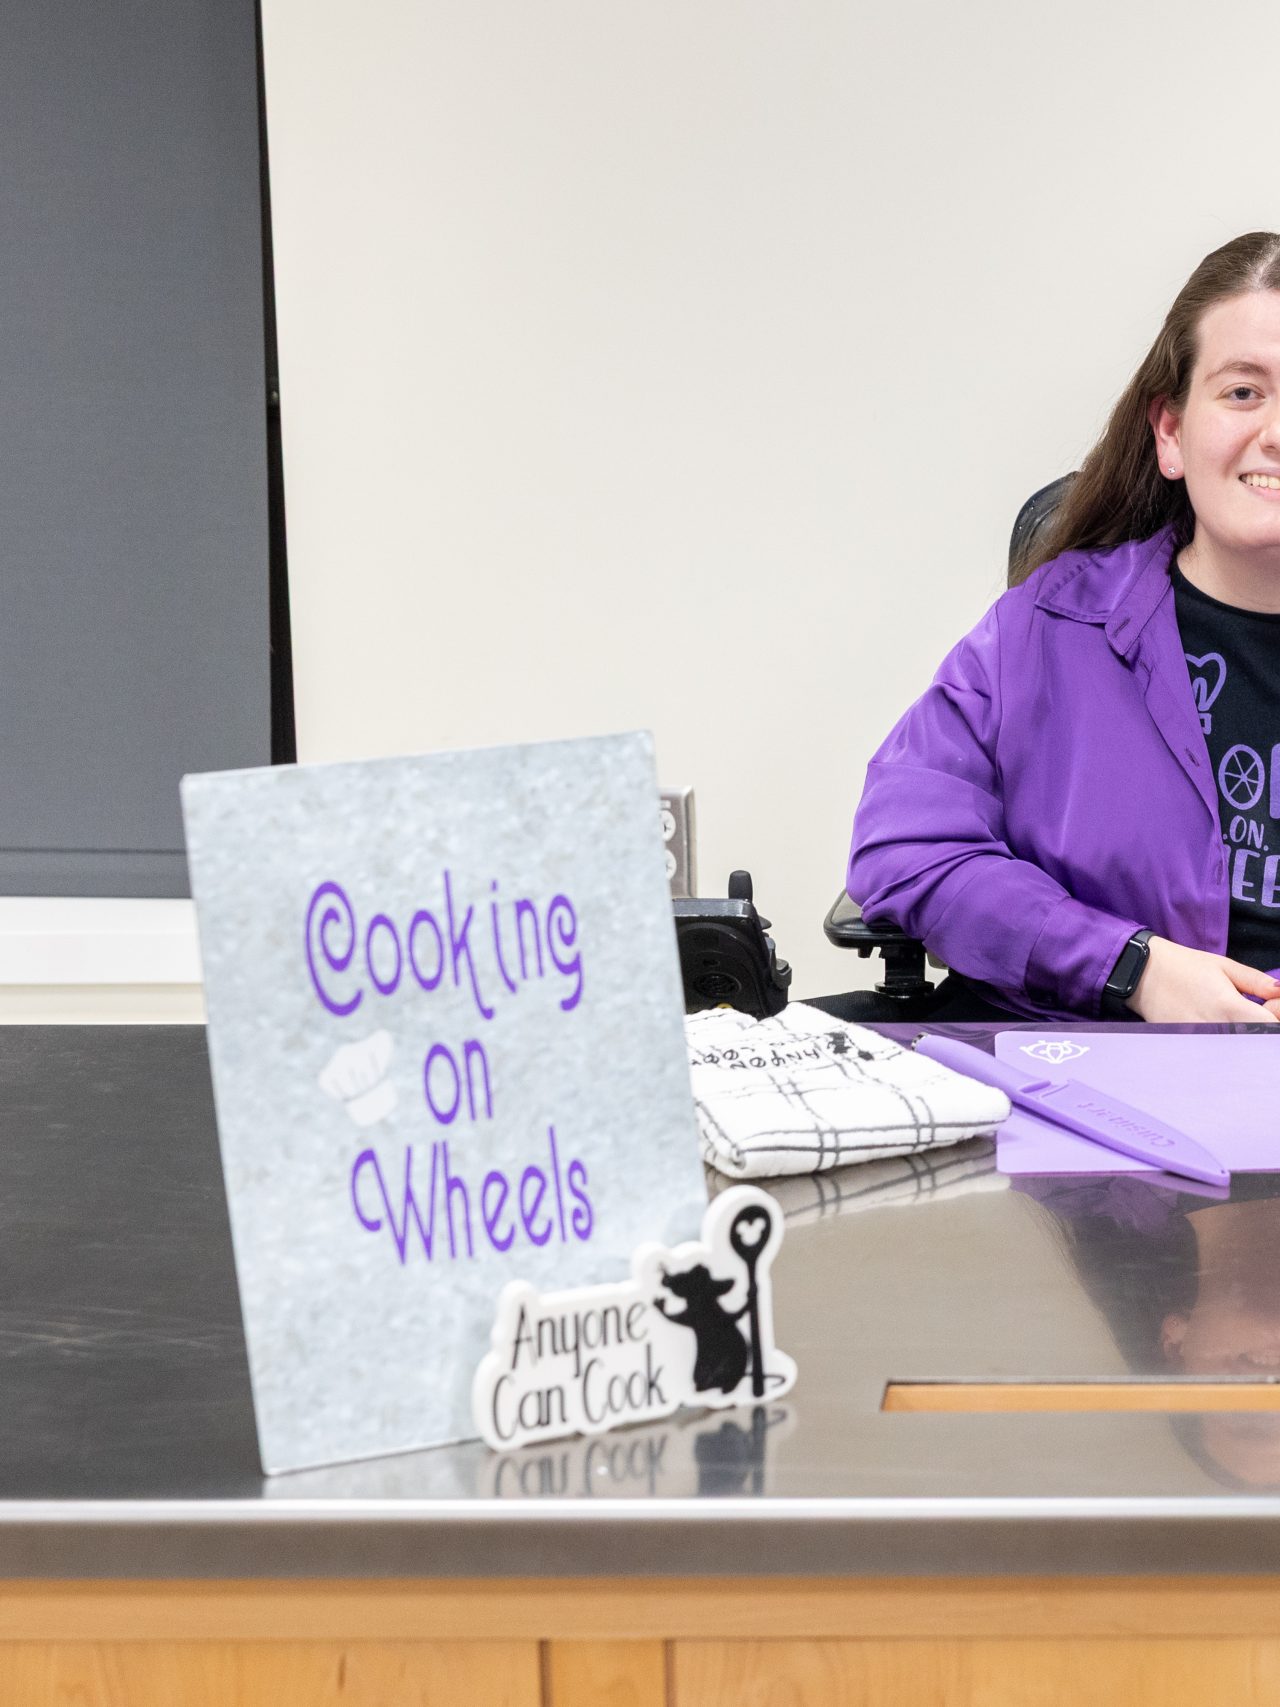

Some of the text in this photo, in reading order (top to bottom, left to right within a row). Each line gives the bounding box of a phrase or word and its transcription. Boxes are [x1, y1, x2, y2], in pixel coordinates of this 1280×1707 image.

[305, 869, 584, 1020] Cooking
[423, 1039, 494, 1125] on
[351, 1125, 593, 1266] Wheels
[511, 1302, 649, 1379] Anyone
[493, 1341, 667, 1441] Can Cook
